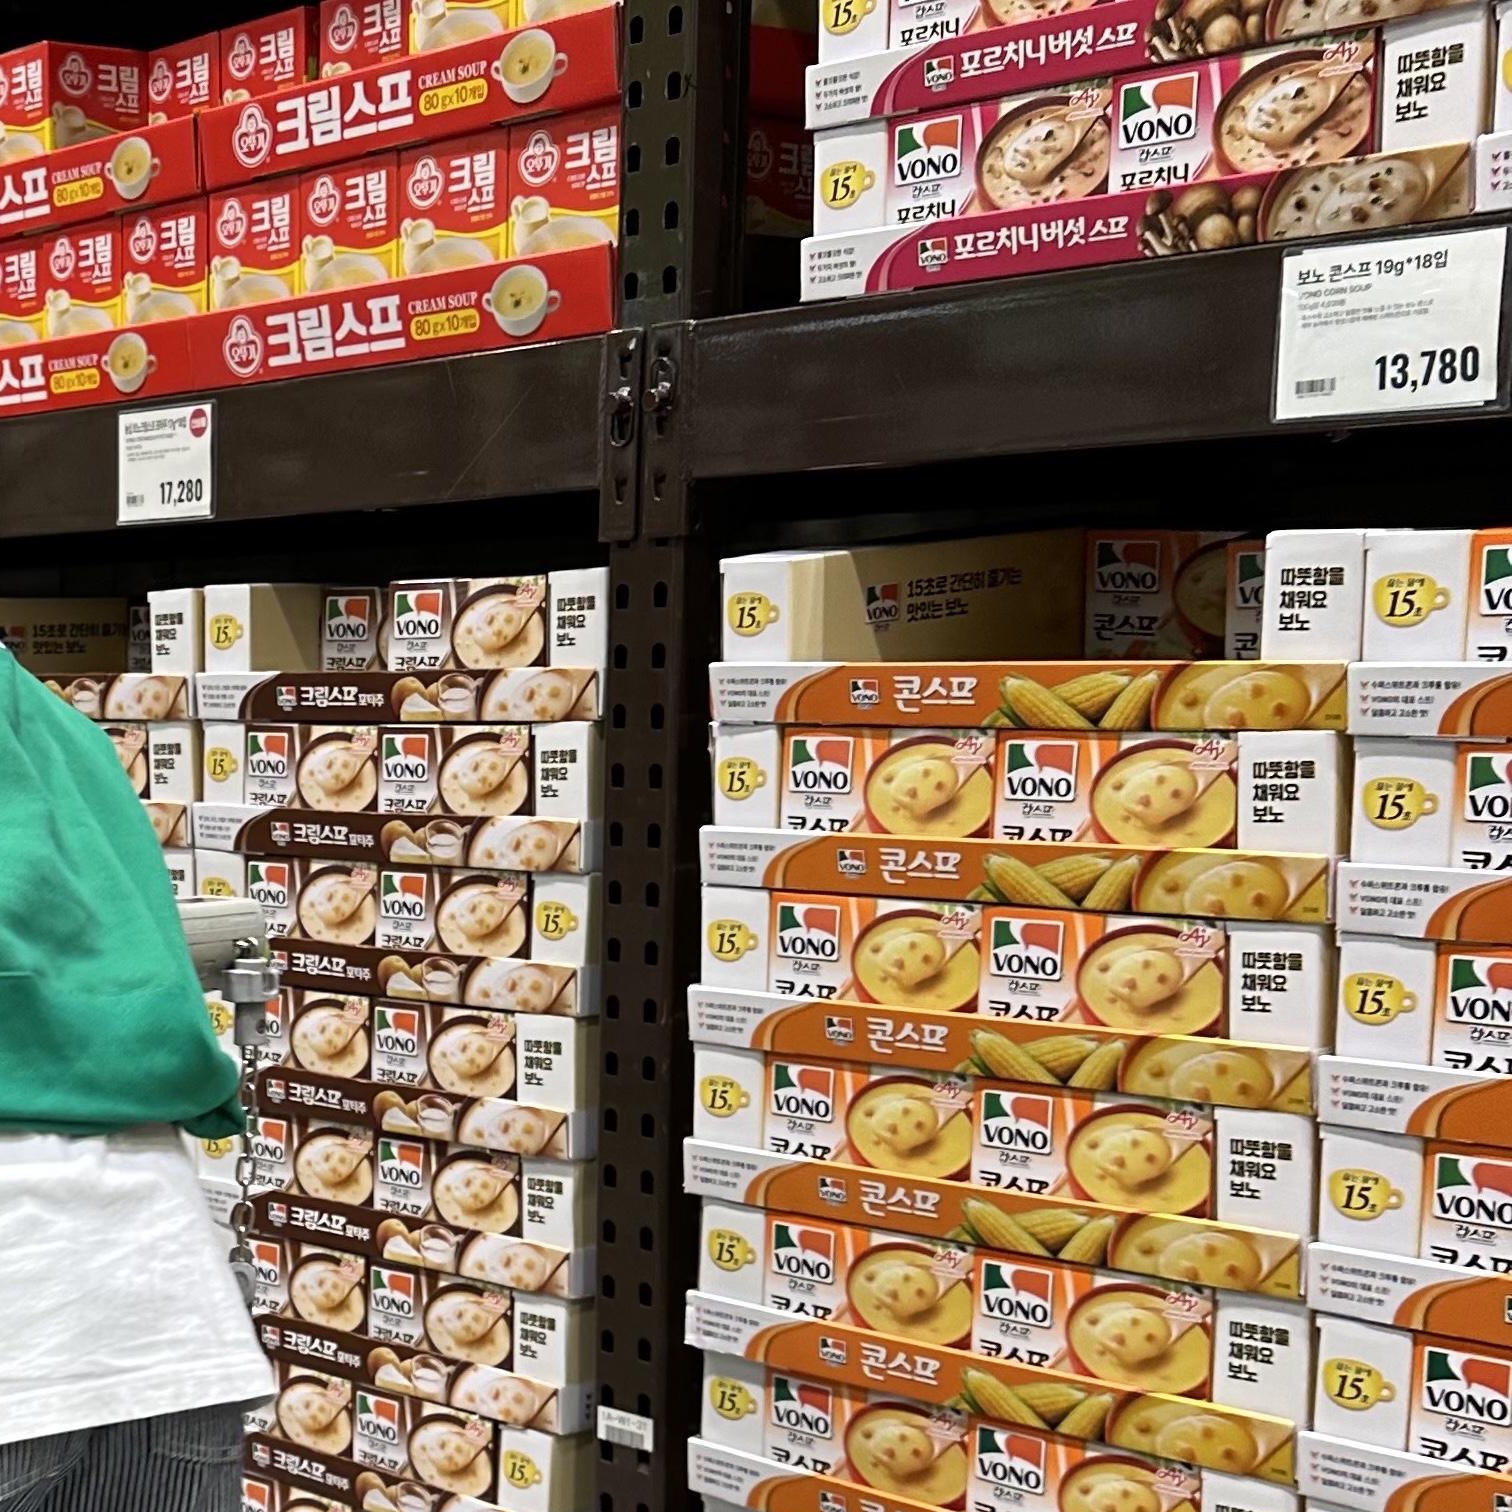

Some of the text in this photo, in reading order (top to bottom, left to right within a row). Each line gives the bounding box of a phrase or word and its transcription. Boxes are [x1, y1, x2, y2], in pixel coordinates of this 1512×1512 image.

[900, 18, 960, 46] 포르치니
[961, 23, 1137, 78] 포르치니버섯 스프
[1397, 42, 1464, 74] 따뜻함을
[418, 60, 487, 89] CREAM SOUP
[1395, 74, 1447, 99] 채워요
[276, 70, 415, 156] 크림스프
[1395, 101, 1429, 123] 보노
[1122, 114, 1193, 145] VONO
[52, 166, 79, 185] CREAM
[897, 152, 957, 182] VONO
[1120, 164, 1189, 192] 포르치니
[896, 200, 956, 224] 포르치니
[954, 216, 1129, 260] 포르치니버섯 스프
[1297, 269, 1325, 286] 보노
[1329, 261, 1372, 283] 콘스프
[408, 291, 478, 316] CREAM SOUP
[266, 294, 406, 368] 크림스프
[1375, 345, 1480, 393] 13,780
[160, 478, 203, 506] 17,280
[1096, 562, 1158, 591] VONO
[1280, 566, 1345, 588] 따뜻함을
[1279, 590, 1328, 611] 채워요
[327, 622, 366, 639] VONO
[395, 619, 442, 638] VONO
[1093, 613, 1158, 639] 콘스프
[1279, 612, 1311, 632] 보노
[301, 685, 357, 707] 크림스프
[892, 675, 978, 714] 콘스프
[250, 756, 285, 774] VONO
[385, 761, 427, 780] VONO
[1253, 759, 1315, 780] 따뜻함을
[790, 770, 849, 792] VONO
[1006, 777, 1072, 799] VONO
[1253, 782, 1300, 802] 채워요
[1253, 805, 1285, 824] 보노
[293, 823, 349, 846] 크림스프
[879, 847, 961, 882] 콘스프
[383, 898, 425, 918] VONO
[777, 934, 837, 958] VONO
[291, 951, 345, 979] 크림스프
[992, 956, 1059, 981] VONO
[1241, 950, 1303, 971] 따뜻함을
[1241, 973, 1289, 994] 채워요
[1241, 995, 1272, 1014] 보노
[376, 1034, 416, 1053] VONO
[866, 1019, 948, 1053] 콘스프
[289, 1082, 342, 1109] 크림스프
[774, 1093, 833, 1121] VONO
[984, 1127, 1049, 1153] VONO
[1229, 1139, 1293, 1161] 따뜻함을
[379, 1165, 421, 1185] VONO
[1229, 1160, 1277, 1181] 채워요
[860, 1178, 940, 1219] 콘스프
[1229, 1181, 1261, 1200] 보노
[290, 1206, 344, 1235] 크림스프
[1437, 1193, 1512, 1225] VONO
[774, 1251, 833, 1279] VONO
[372, 1293, 413, 1314] VONO
[983, 1295, 1049, 1323] VONO
[284, 1330, 337, 1361] 크림스프
[1229, 1321, 1290, 1345] 따뜻함을
[859, 1345, 941, 1385] 콘스프
[1229, 1343, 1274, 1365] 채워요
[1229, 1362, 1259, 1383] 보노
[1426, 1385, 1507, 1421] VONO
[359, 1418, 397, 1442] VONO
[773, 1403, 831, 1435] VONO
[273, 1448, 325, 1480] 크림스프
[976, 1459, 1042, 1488] VONO
